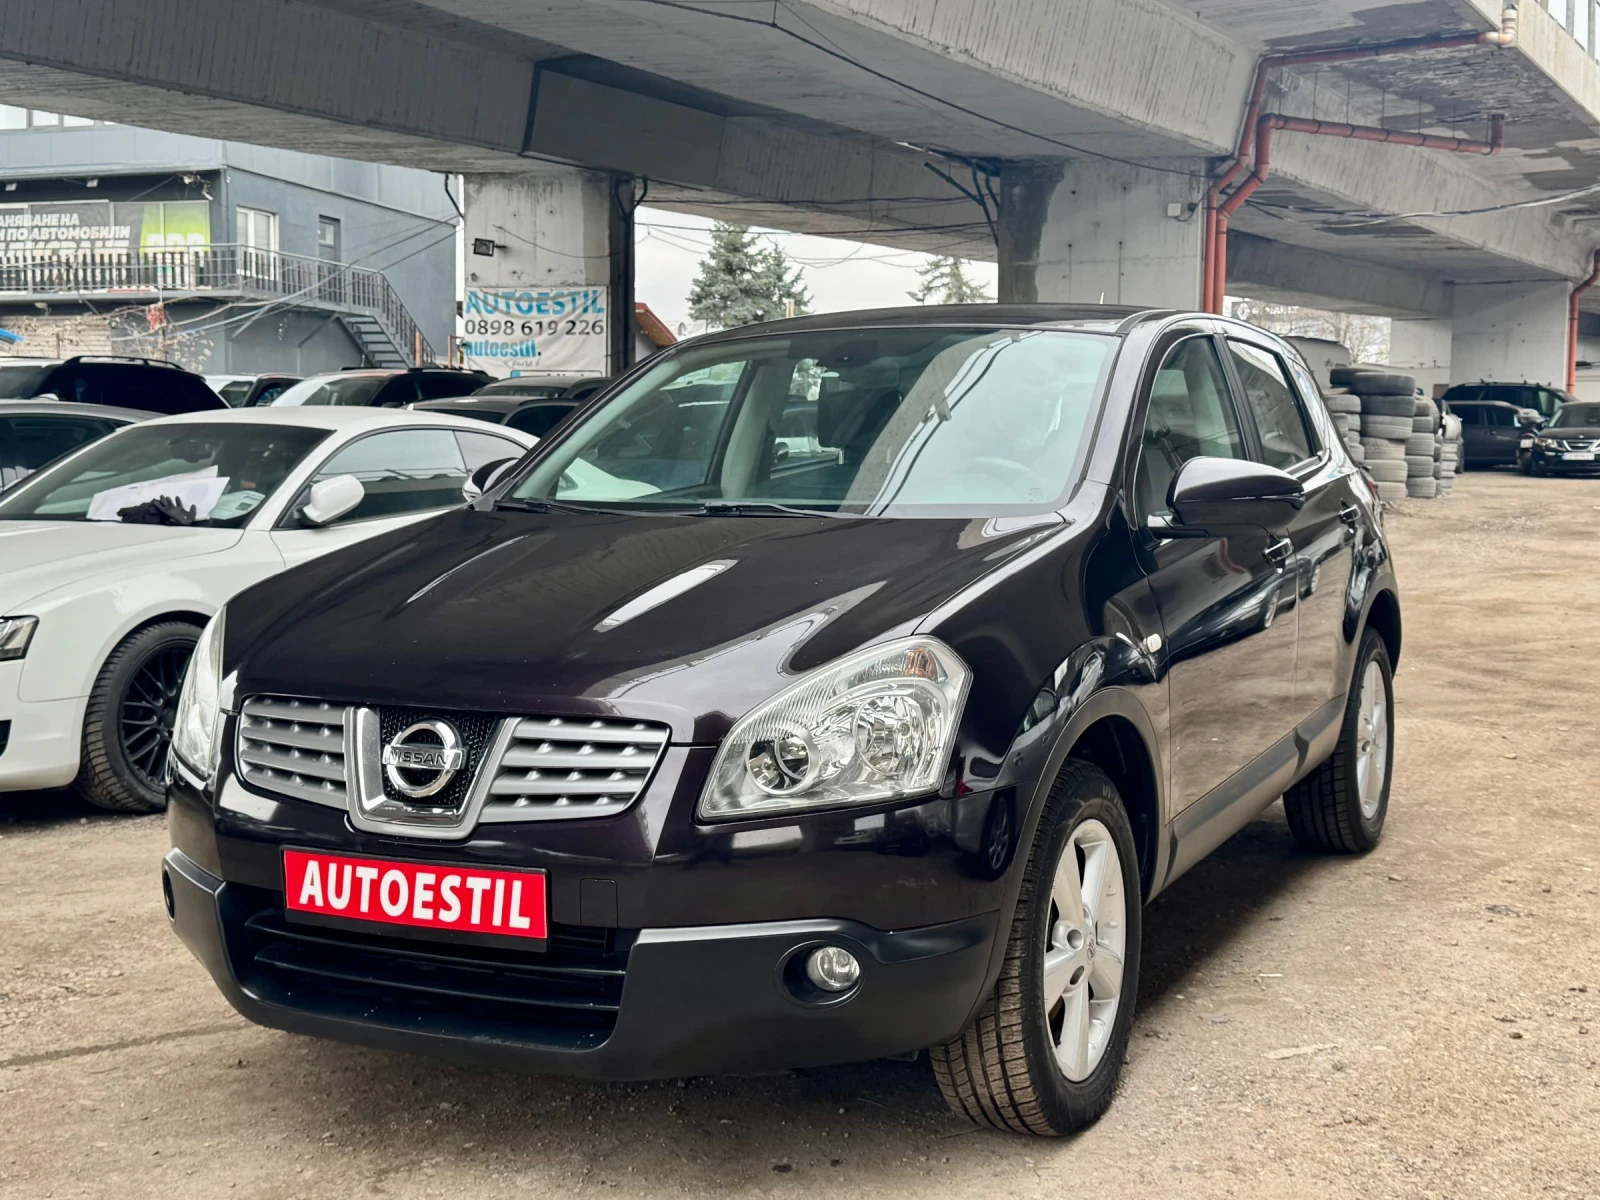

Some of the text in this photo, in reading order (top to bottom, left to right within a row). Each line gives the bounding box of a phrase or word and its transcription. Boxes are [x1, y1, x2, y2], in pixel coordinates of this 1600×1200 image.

[60, 213, 80, 226] НА
[6, 227, 29, 241] ПО
[30, 226, 130, 240] АВТОМОБИЛИ
[465, 289, 605, 315] AUTOESTIL
[465, 319, 605, 337] 0898 619 226
[389, 749, 448, 766] NISSAN
[299, 859, 531, 930] AUTOESTIL
